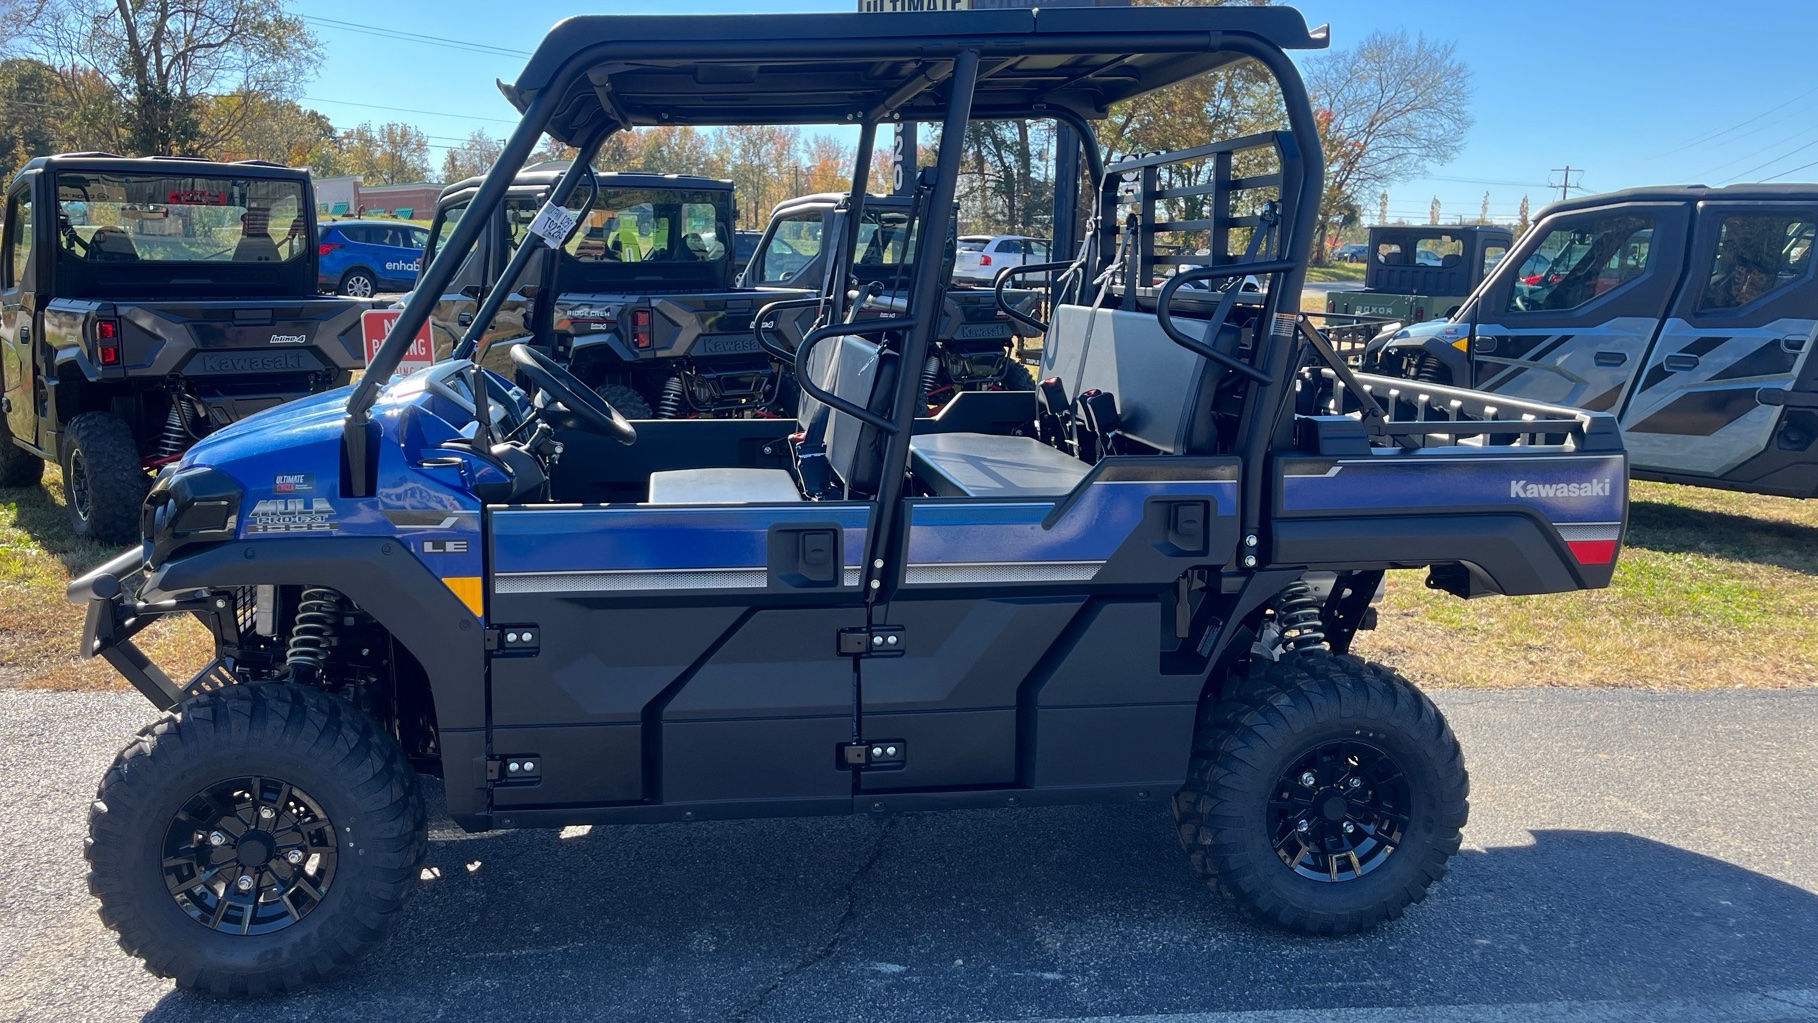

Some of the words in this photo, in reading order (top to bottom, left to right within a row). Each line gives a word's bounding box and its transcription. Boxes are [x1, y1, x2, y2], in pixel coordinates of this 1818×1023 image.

[1356, 305, 1393, 315] ROXOR
[962, 325, 1005, 338] Kawasaki
[203, 353, 303, 372] Kawasaki
[276, 475, 304, 484] ULTIMATE
[1510, 478, 1610, 498] Kawasaki
[249, 498, 337, 517] MULE
[423, 541, 468, 553] LE
